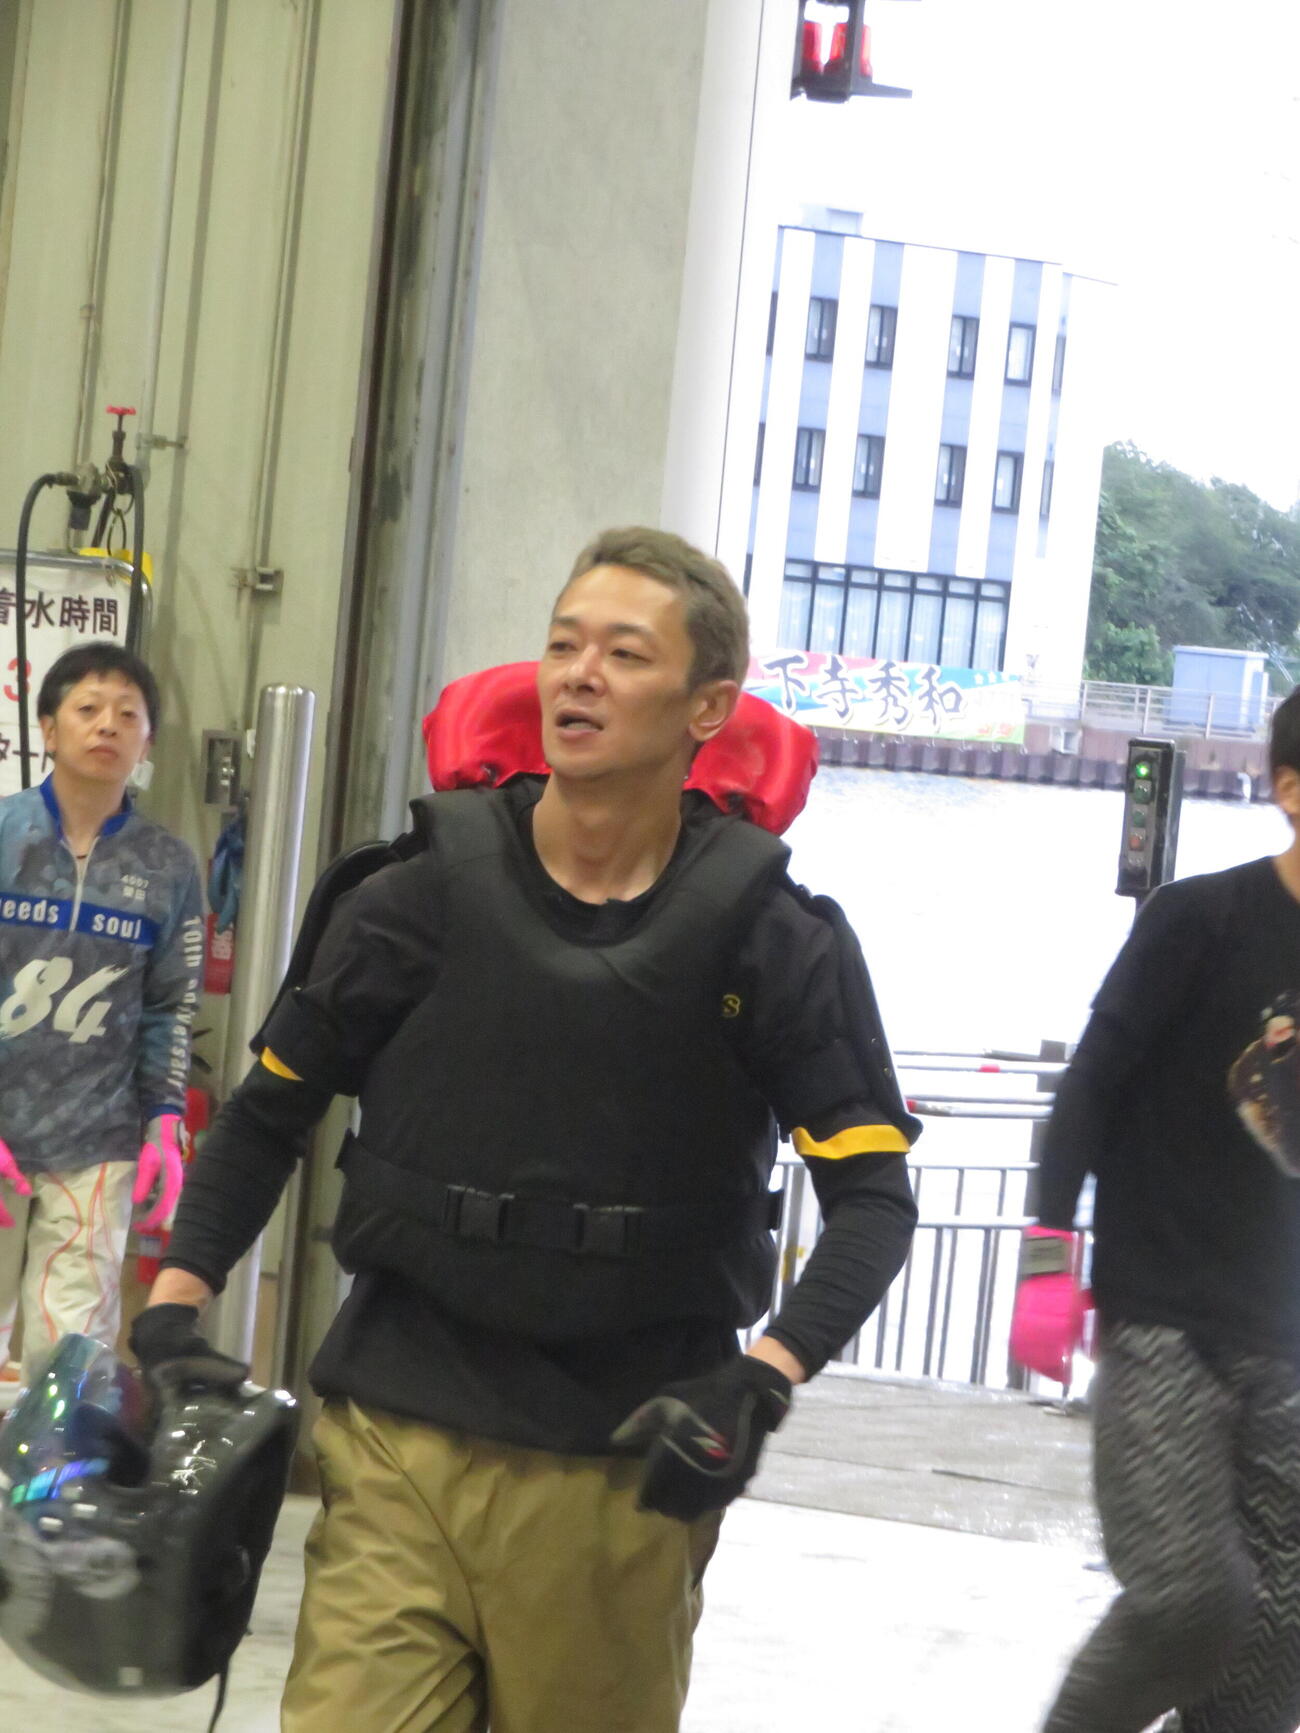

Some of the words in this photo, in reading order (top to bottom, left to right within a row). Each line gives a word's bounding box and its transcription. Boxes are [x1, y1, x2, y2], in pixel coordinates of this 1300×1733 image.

[763, 654, 964, 726] 下寺秀和
[0, 898, 60, 924] eeds
[92, 914, 142, 939] soul
